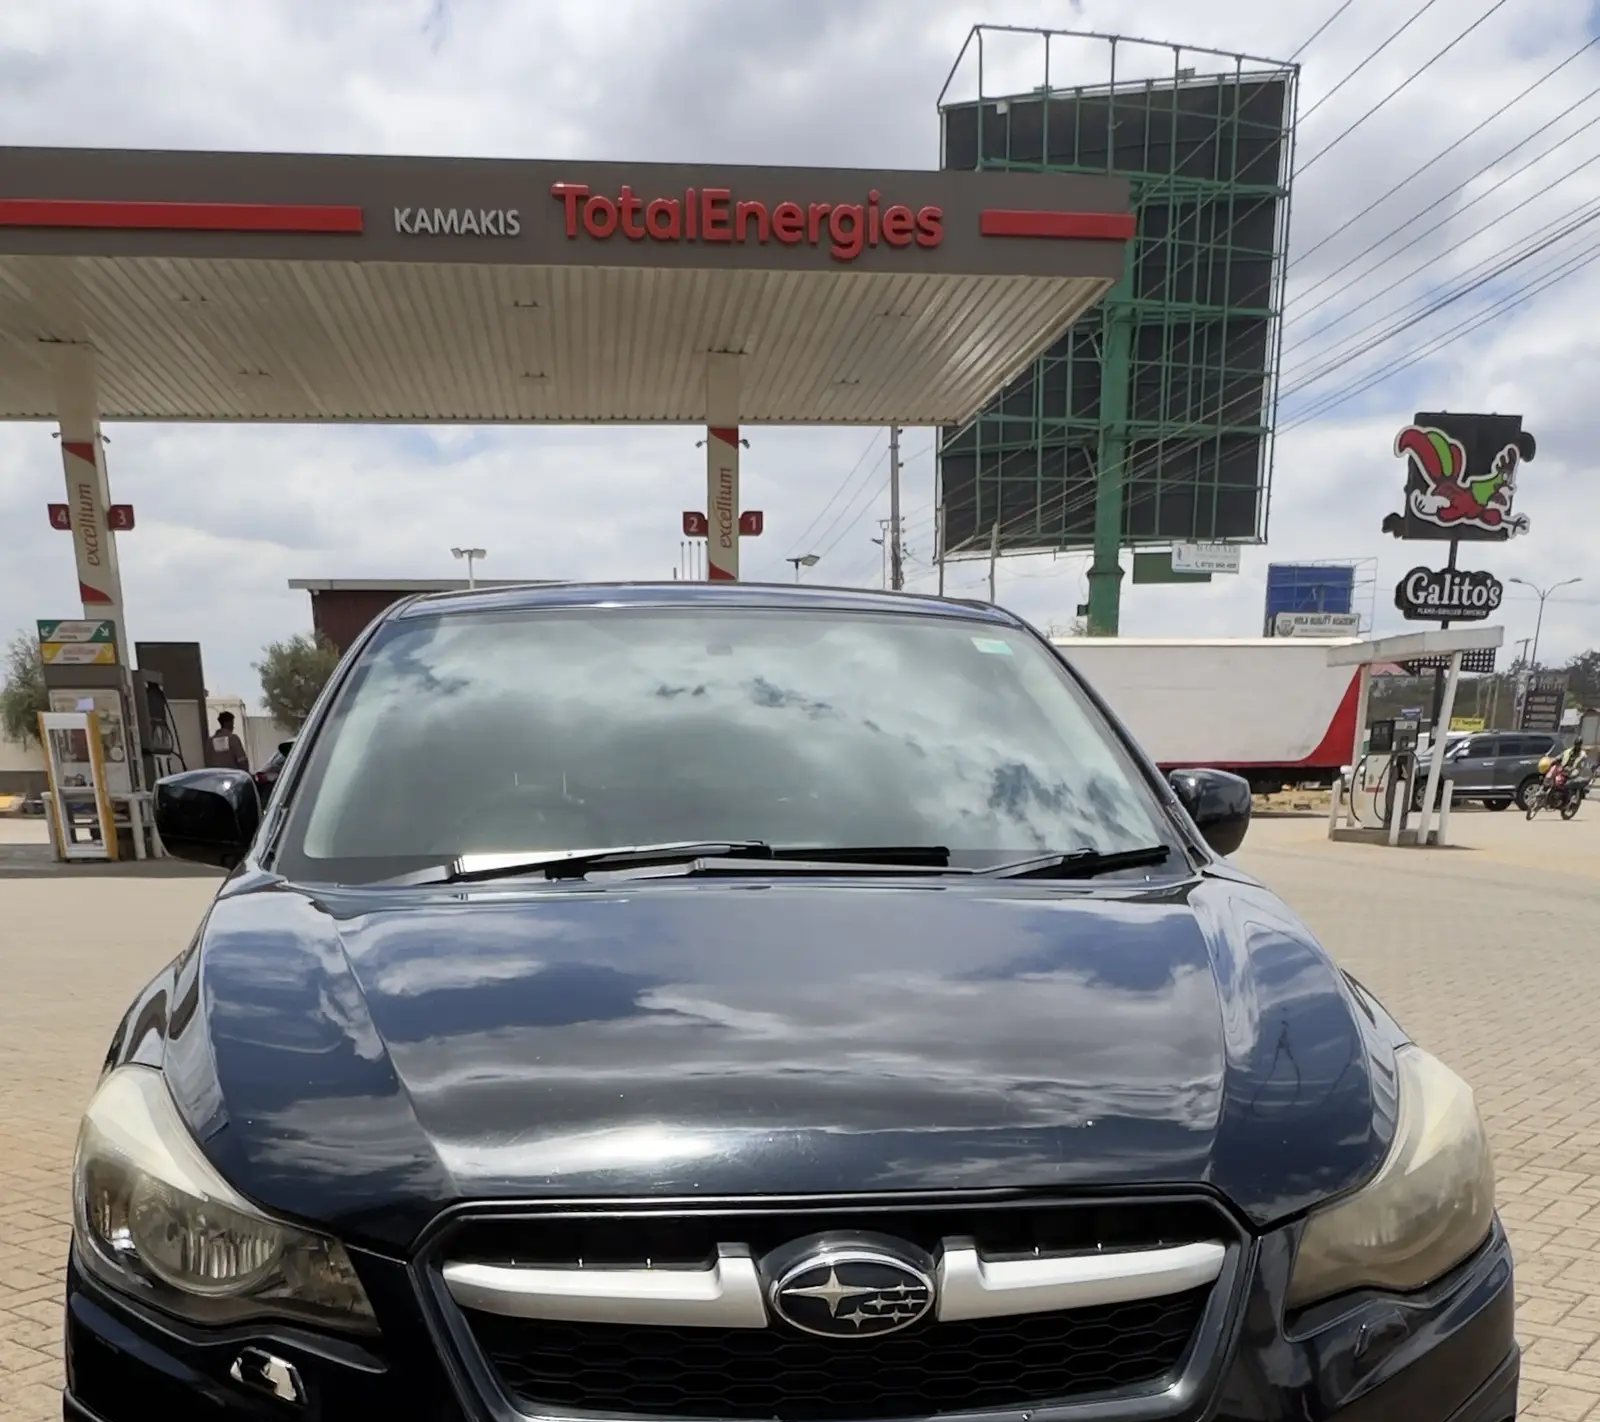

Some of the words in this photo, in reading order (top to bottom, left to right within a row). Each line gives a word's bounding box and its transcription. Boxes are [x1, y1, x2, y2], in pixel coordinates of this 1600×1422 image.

[393, 206, 521, 236] KAMAKIS
[550, 181, 945, 260] TotalEnergies
[57, 509, 67, 524] 4
[119, 510, 127, 525] 3
[715, 467, 732, 548] excellium
[78, 483, 100, 566] excellium
[689, 517, 698, 531] 2
[1406, 572, 1501, 607] Galito's
